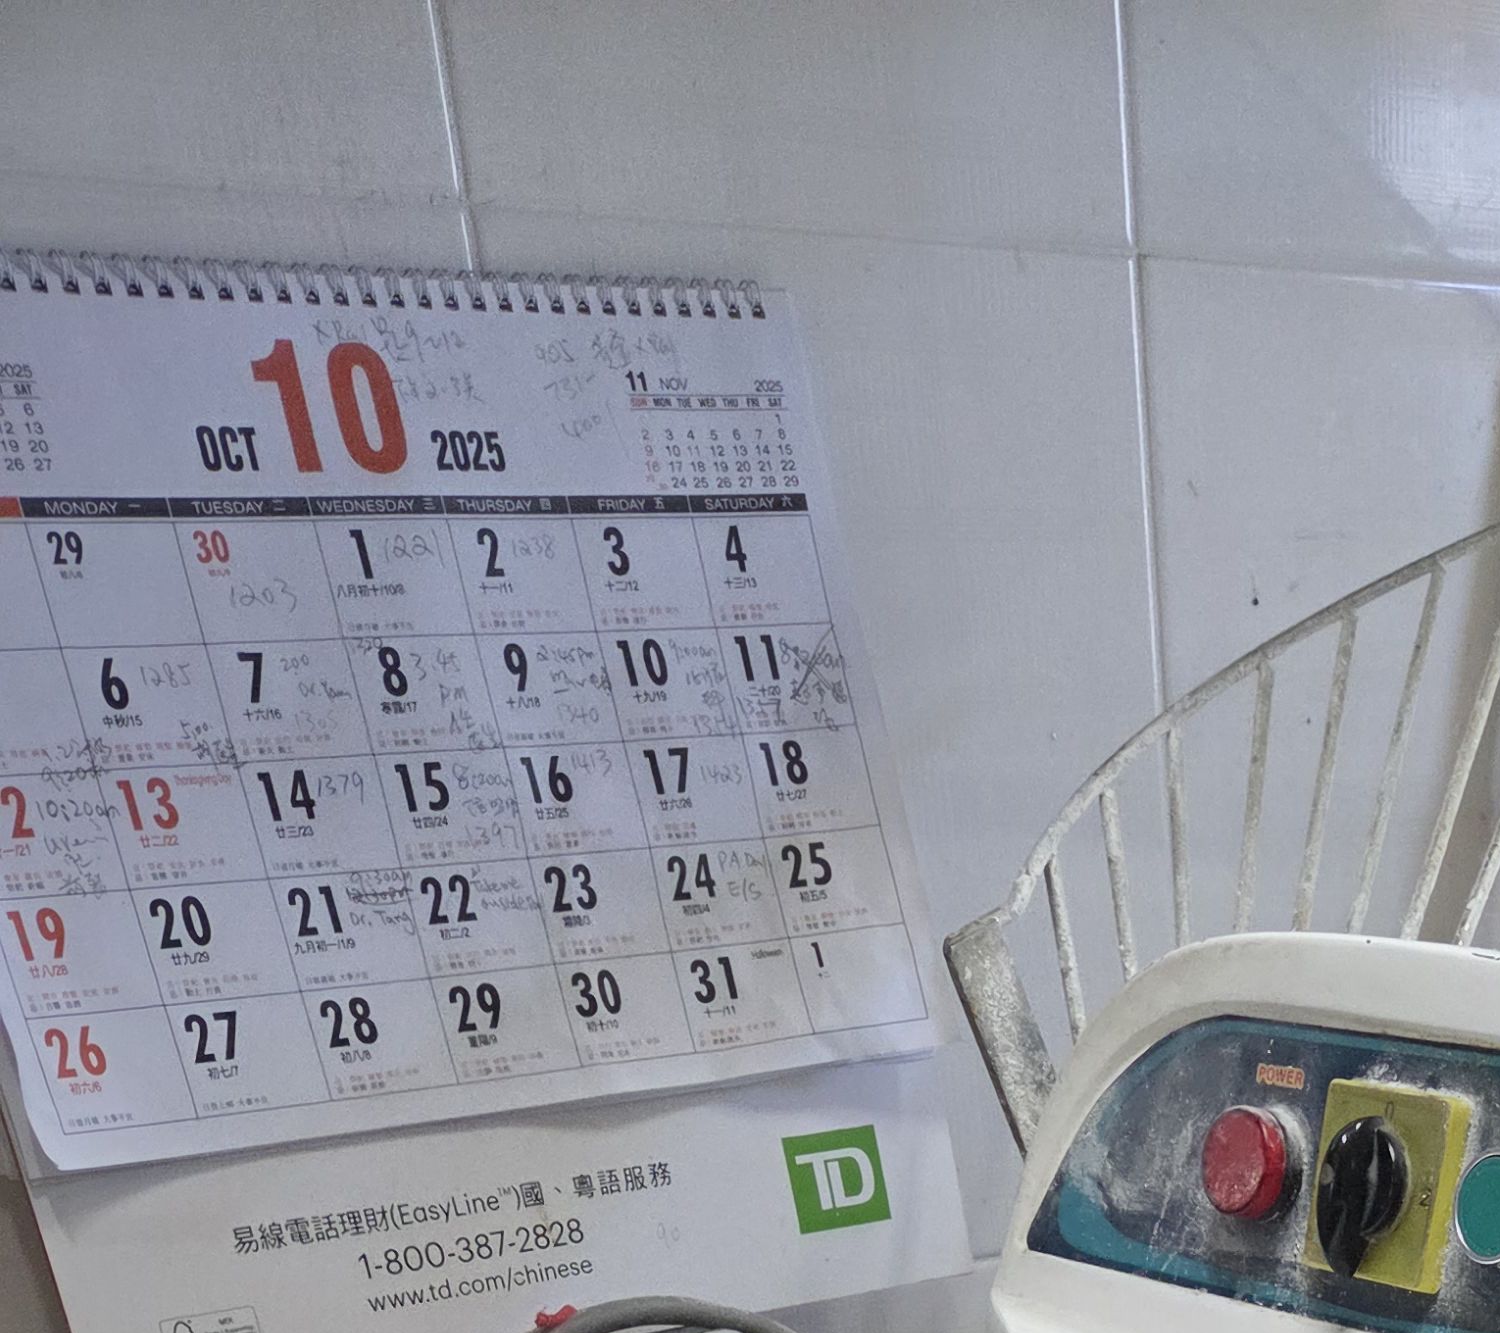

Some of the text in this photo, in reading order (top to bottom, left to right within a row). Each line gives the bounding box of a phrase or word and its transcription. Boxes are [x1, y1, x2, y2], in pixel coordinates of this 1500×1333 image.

[14, 384, 33, 396] SAT
[625, 371, 783, 392] 11 NOV 2025
[24, 403, 34, 416] 6
[26, 422, 44, 434] 13
[196, 425, 260, 472] OCT
[251, 338, 409, 474] 10
[431, 430, 507, 473] 2025
[1, 439, 49, 453] 19 20
[642, 429, 787, 441] 2 3 4 5 6 7 8
[645, 445, 793, 458] 9 10 11 12 13 14 15
[5, 458, 52, 471] 26 27
[645, 460, 797, 473] 16 17 18 19 20 21 22
[671, 477, 688, 489] 24
[693, 477, 709, 489] 25
[716, 477, 732, 489] 26
[738, 477, 754, 489] 27
[761, 476, 777, 488] 28
[784, 476, 800, 488] 29
[43, 501, 118, 516] MONDAY
[191, 500, 264, 515] TUESDAY
[316, 499, 414, 514] WEDNESDAY
[458, 498, 532, 513] THURSDAY
[597, 498, 646, 511] FRIDAY
[704, 496, 776, 511] SATURDAY
[46, 531, 83, 565] 29
[193, 530, 230, 563] 30
[350, 529, 374, 580] 1
[477, 527, 505, 578] 2
[603, 526, 630, 576] 3
[724, 525, 748, 573] 4
[236, 652, 264, 704] 7
[378, 646, 408, 697] 8
[503, 643, 528, 692] 9
[616, 638, 668, 687] 10
[734, 635, 780, 682] 11
[101, 658, 130, 710] 6
[394, 761, 450, 813] 15
[520, 756, 573, 804] 16
[643, 747, 689, 795] 17
[758, 740, 809, 786] 18
[0, 785, 36, 839] 2
[115, 777, 180, 831] 13
[257, 769, 316, 822] 14
[544, 864, 598, 913] 23
[667, 853, 716, 901] 24
[781, 841, 832, 889] 25
[150, 895, 212, 950] 20
[287, 885, 343, 937] 21
[420, 874, 478, 925] 22
[6, 907, 65, 962] 19
[810, 941, 824, 969] 1
[571, 969, 622, 1018] 30
[690, 956, 739, 1004] 31
[319, 997, 379, 1049] 28
[448, 982, 501, 1033] 29
[43, 1025, 107, 1079] 26
[183, 1010, 237, 1064] 27
[1258, 1066, 1305, 1088] POWER
[795, 1146, 877, 1214] TD
[357, 1217, 586, 1281] 1-800-387-2828
[367, 1257, 595, 1315] www.td.com/chinese
